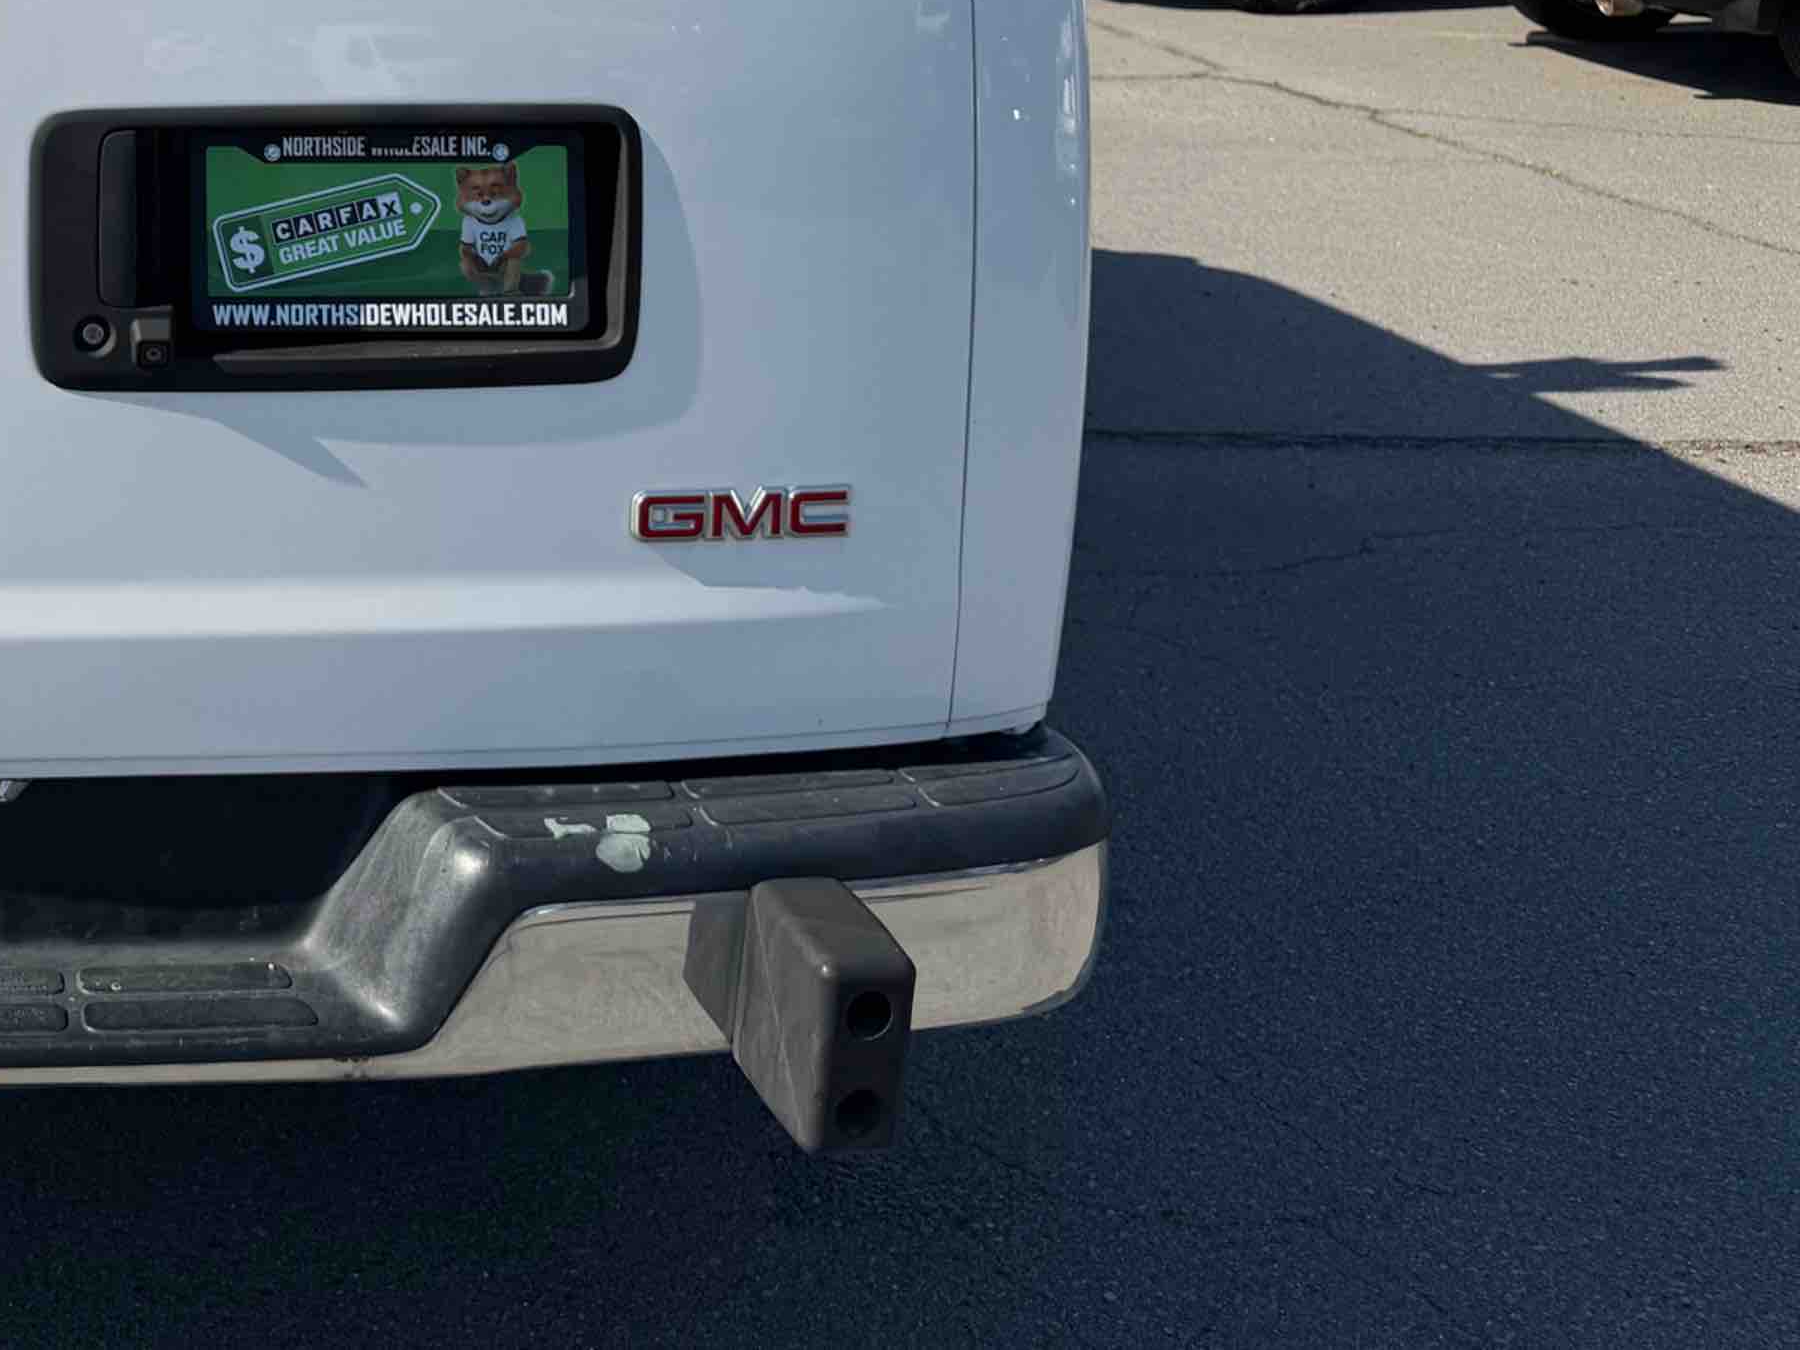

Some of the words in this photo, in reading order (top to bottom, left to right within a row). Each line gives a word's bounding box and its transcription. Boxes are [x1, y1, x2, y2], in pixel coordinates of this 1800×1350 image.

[282, 136, 367, 157] NORTHSIDE
[461, 136, 491, 157] INC.
[273, 197, 401, 241] CARFAX
[280, 234, 341, 264] GREAT
[343, 219, 407, 249] VALUE
[480, 231, 507, 243] CAR
[212, 303, 569, 327] WWW.NORTHSIDEWHOLESALE.COM
[630, 485, 850, 541] GMC
